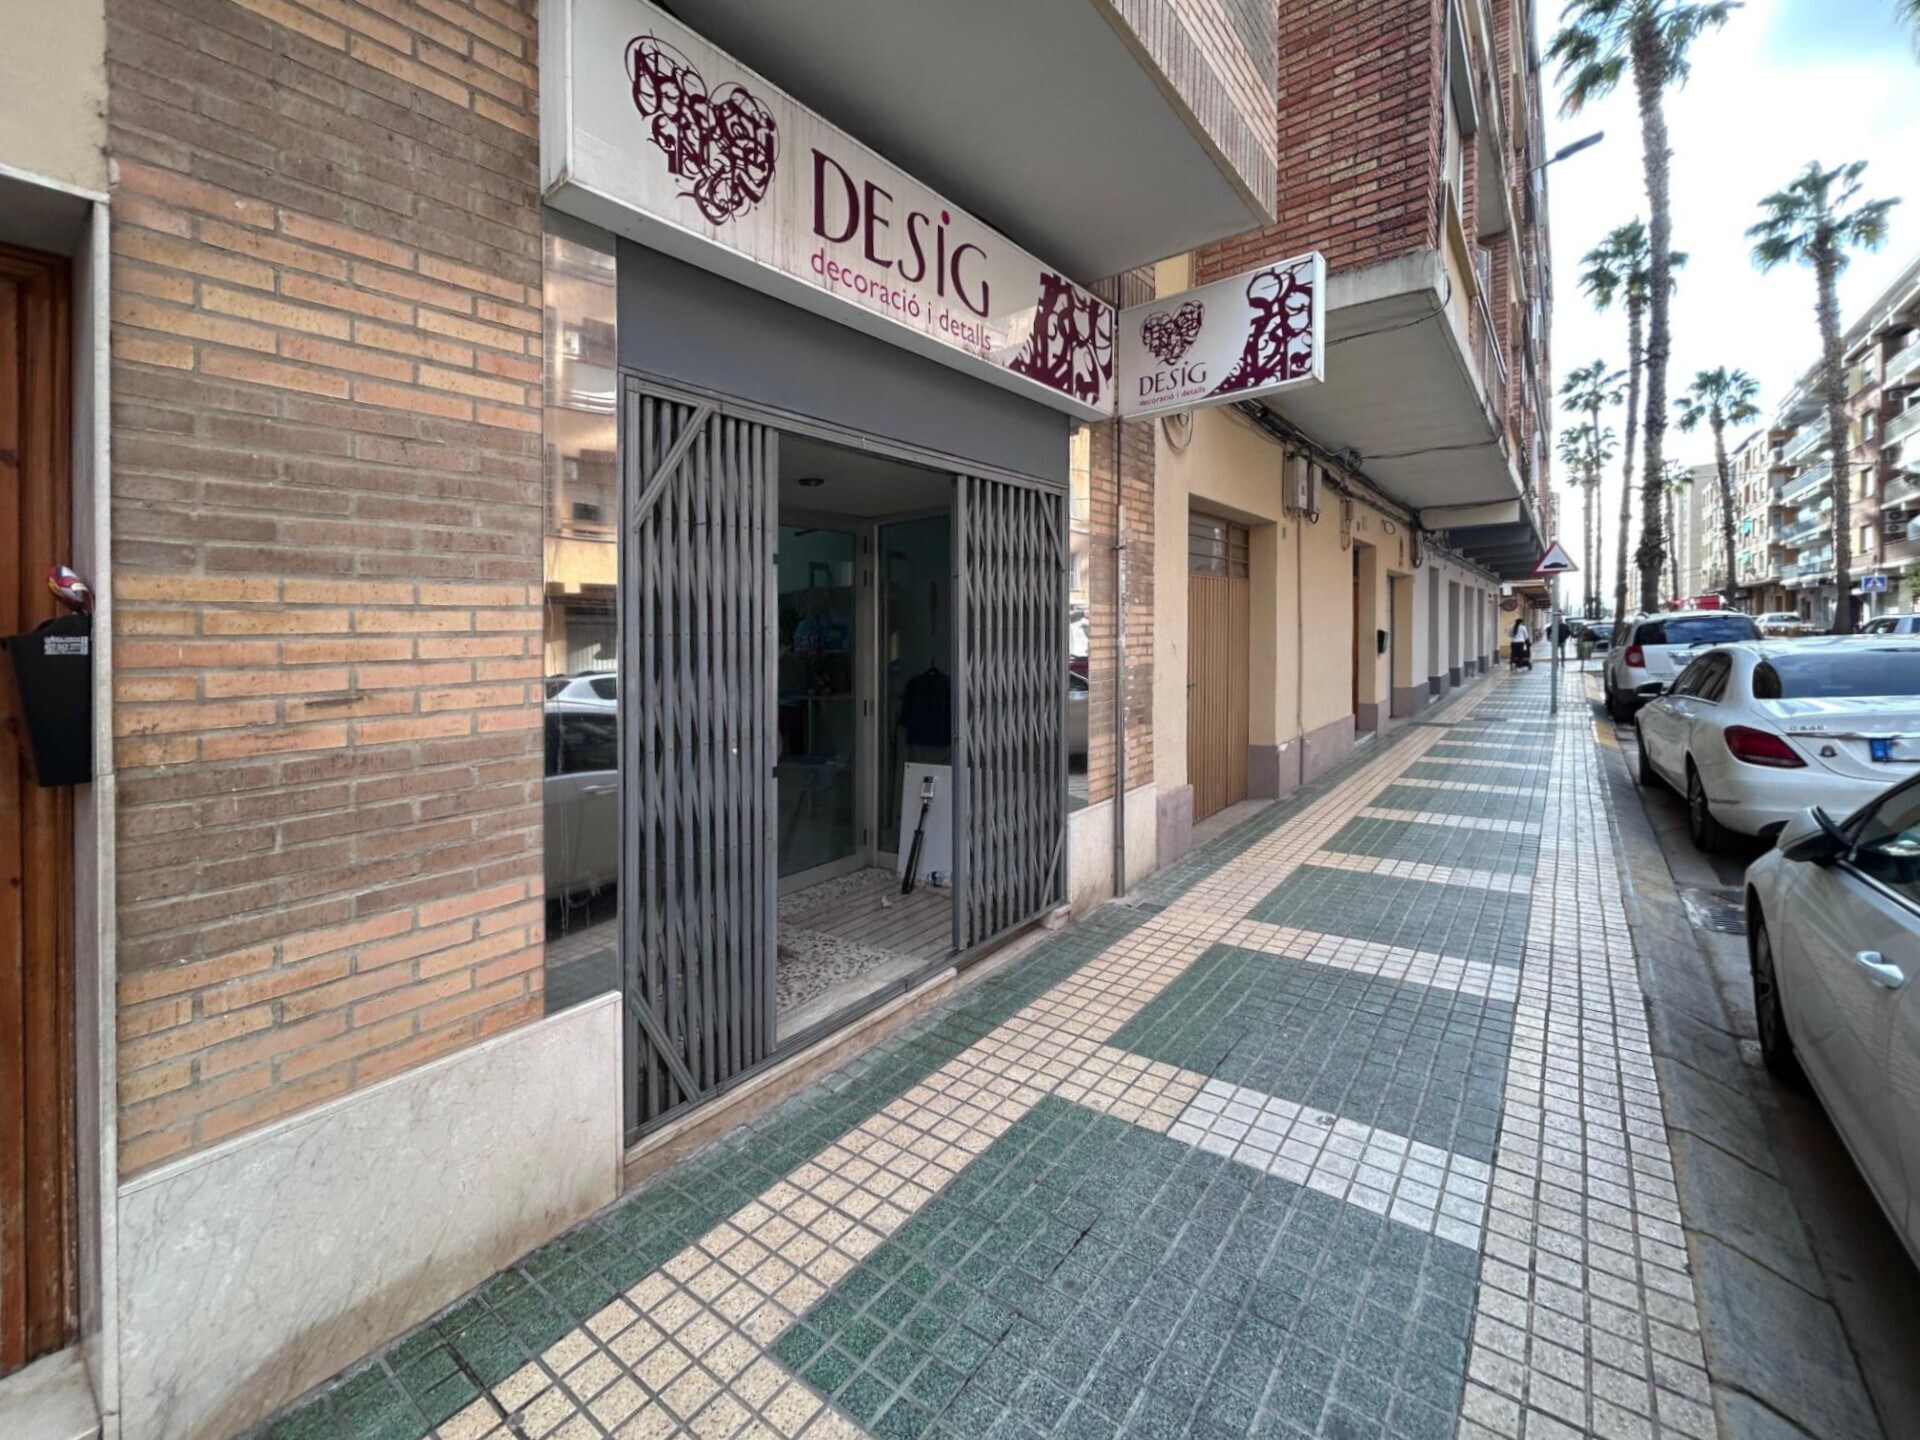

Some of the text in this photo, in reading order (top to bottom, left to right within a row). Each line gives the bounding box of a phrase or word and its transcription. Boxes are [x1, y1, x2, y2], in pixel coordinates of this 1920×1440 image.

[811, 247, 920, 317] decoració
[939, 308, 991, 351] detalls
[1139, 393, 1175, 407] decoració
[1181, 386, 1206, 397] detalls
